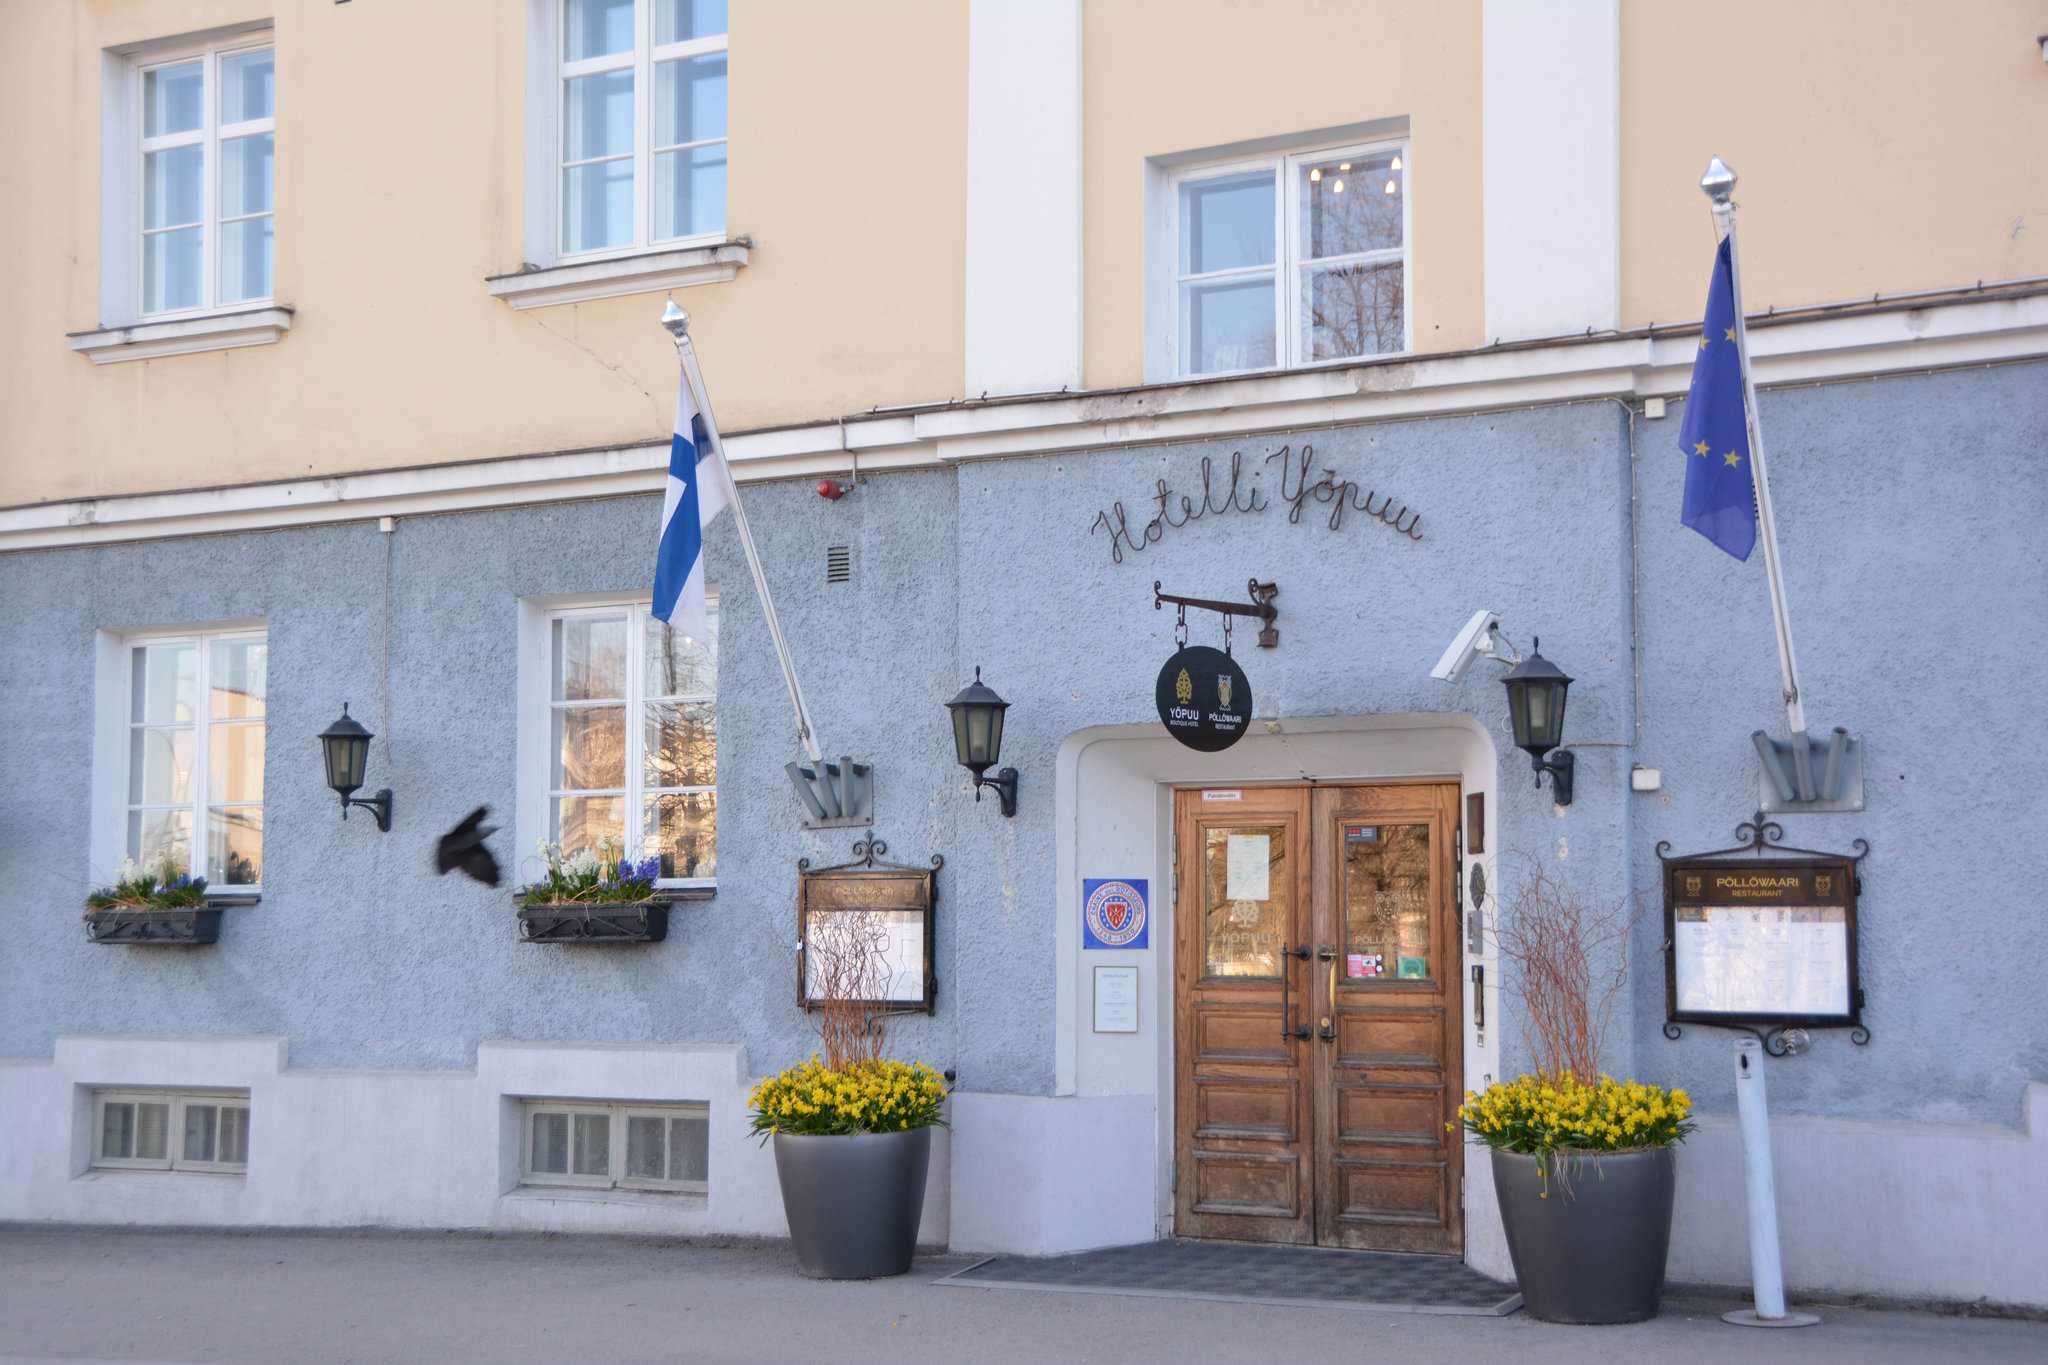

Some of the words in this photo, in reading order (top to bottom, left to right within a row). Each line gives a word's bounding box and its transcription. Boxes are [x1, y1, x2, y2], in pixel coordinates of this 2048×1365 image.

[1091, 451, 1268, 563] Hotelli
[1169, 706, 1199, 721] YÖPUU
[1716, 876, 1799, 888] PÖLLÖWAARI
[1731, 889, 1783, 898] RESTAURANT
